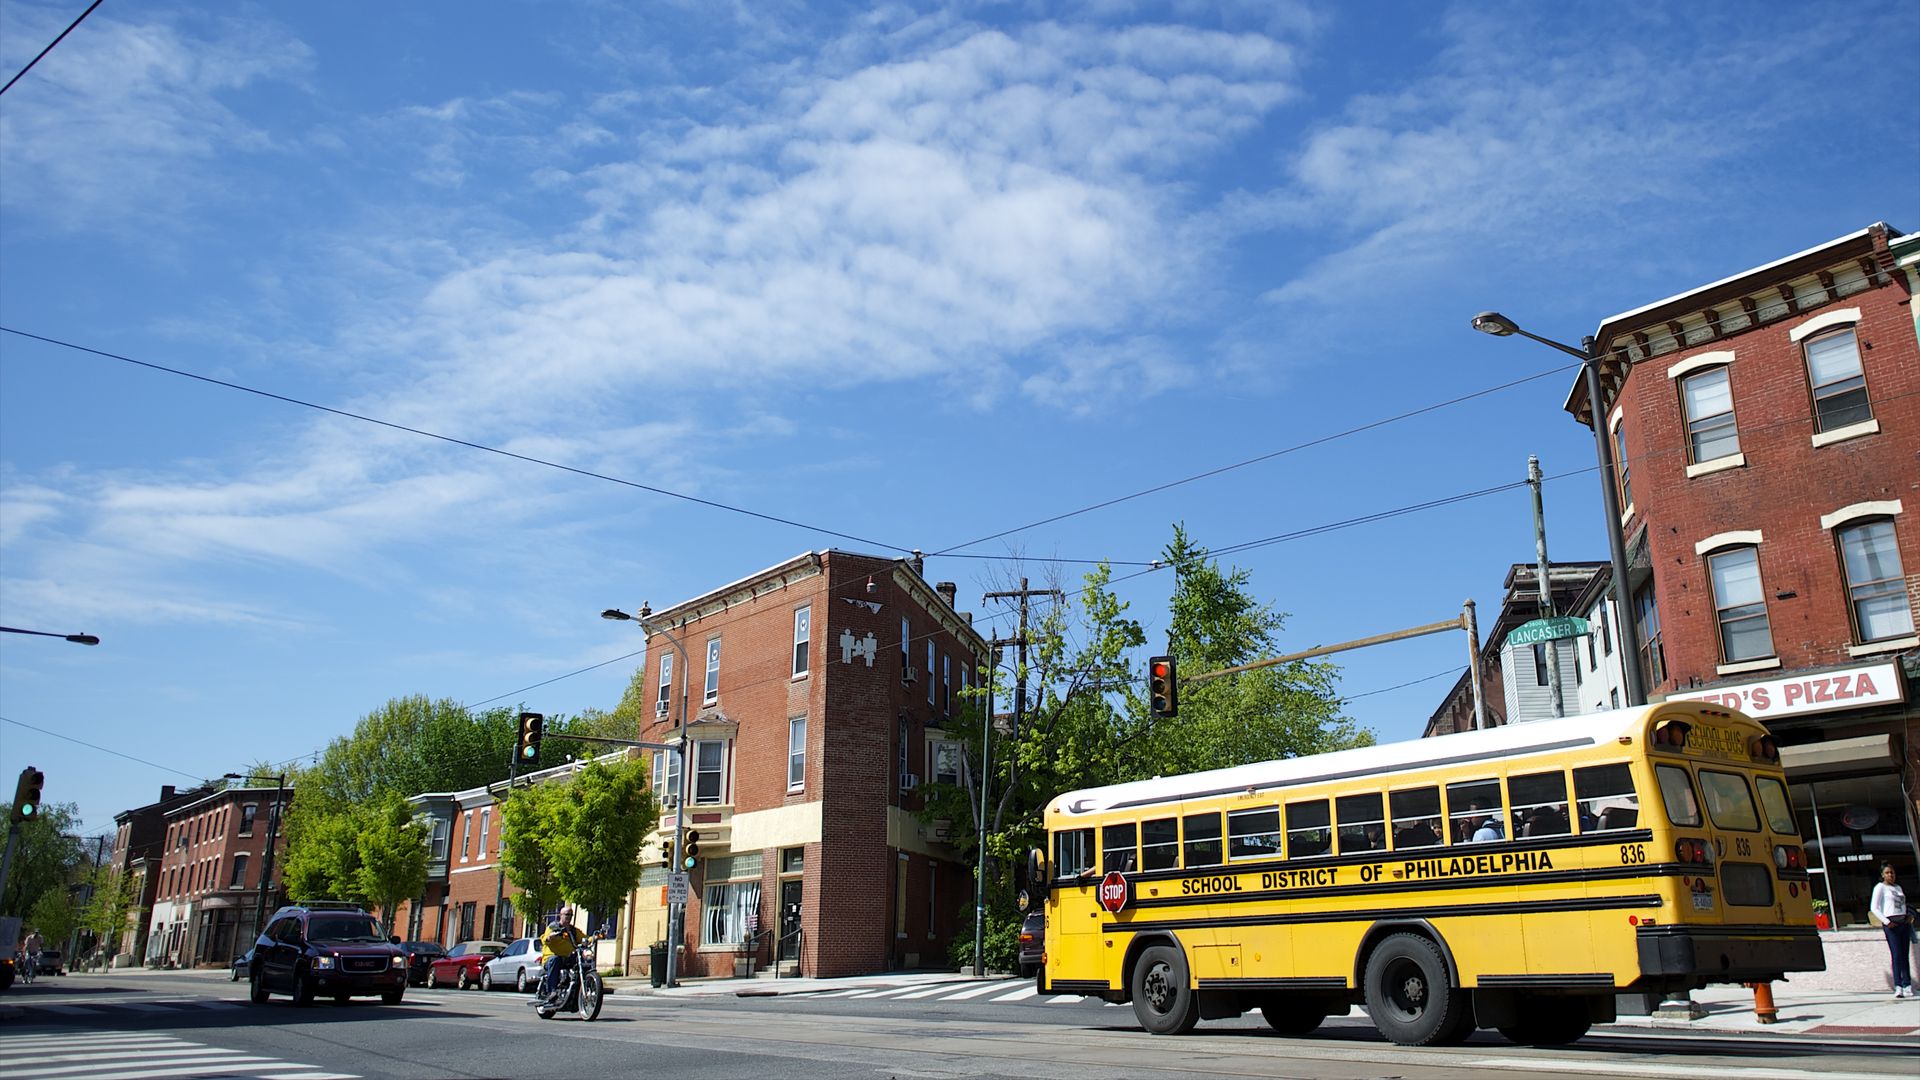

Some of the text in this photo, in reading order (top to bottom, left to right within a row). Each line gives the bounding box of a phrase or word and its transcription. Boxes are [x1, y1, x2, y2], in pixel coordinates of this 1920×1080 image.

[1510, 624, 1585, 645] LANCASTER AV
[1686, 672, 1878, 712] D'S PIZZA
[1688, 724, 1745, 754] SCHOOL BUS
[1620, 844, 1645, 864] 836
[1735, 837, 1751, 857] 836
[1182, 851, 1553, 895] SCHOOL DISTRICT OF PHILADELPHIA
[1104, 884, 1123, 900] STOP
